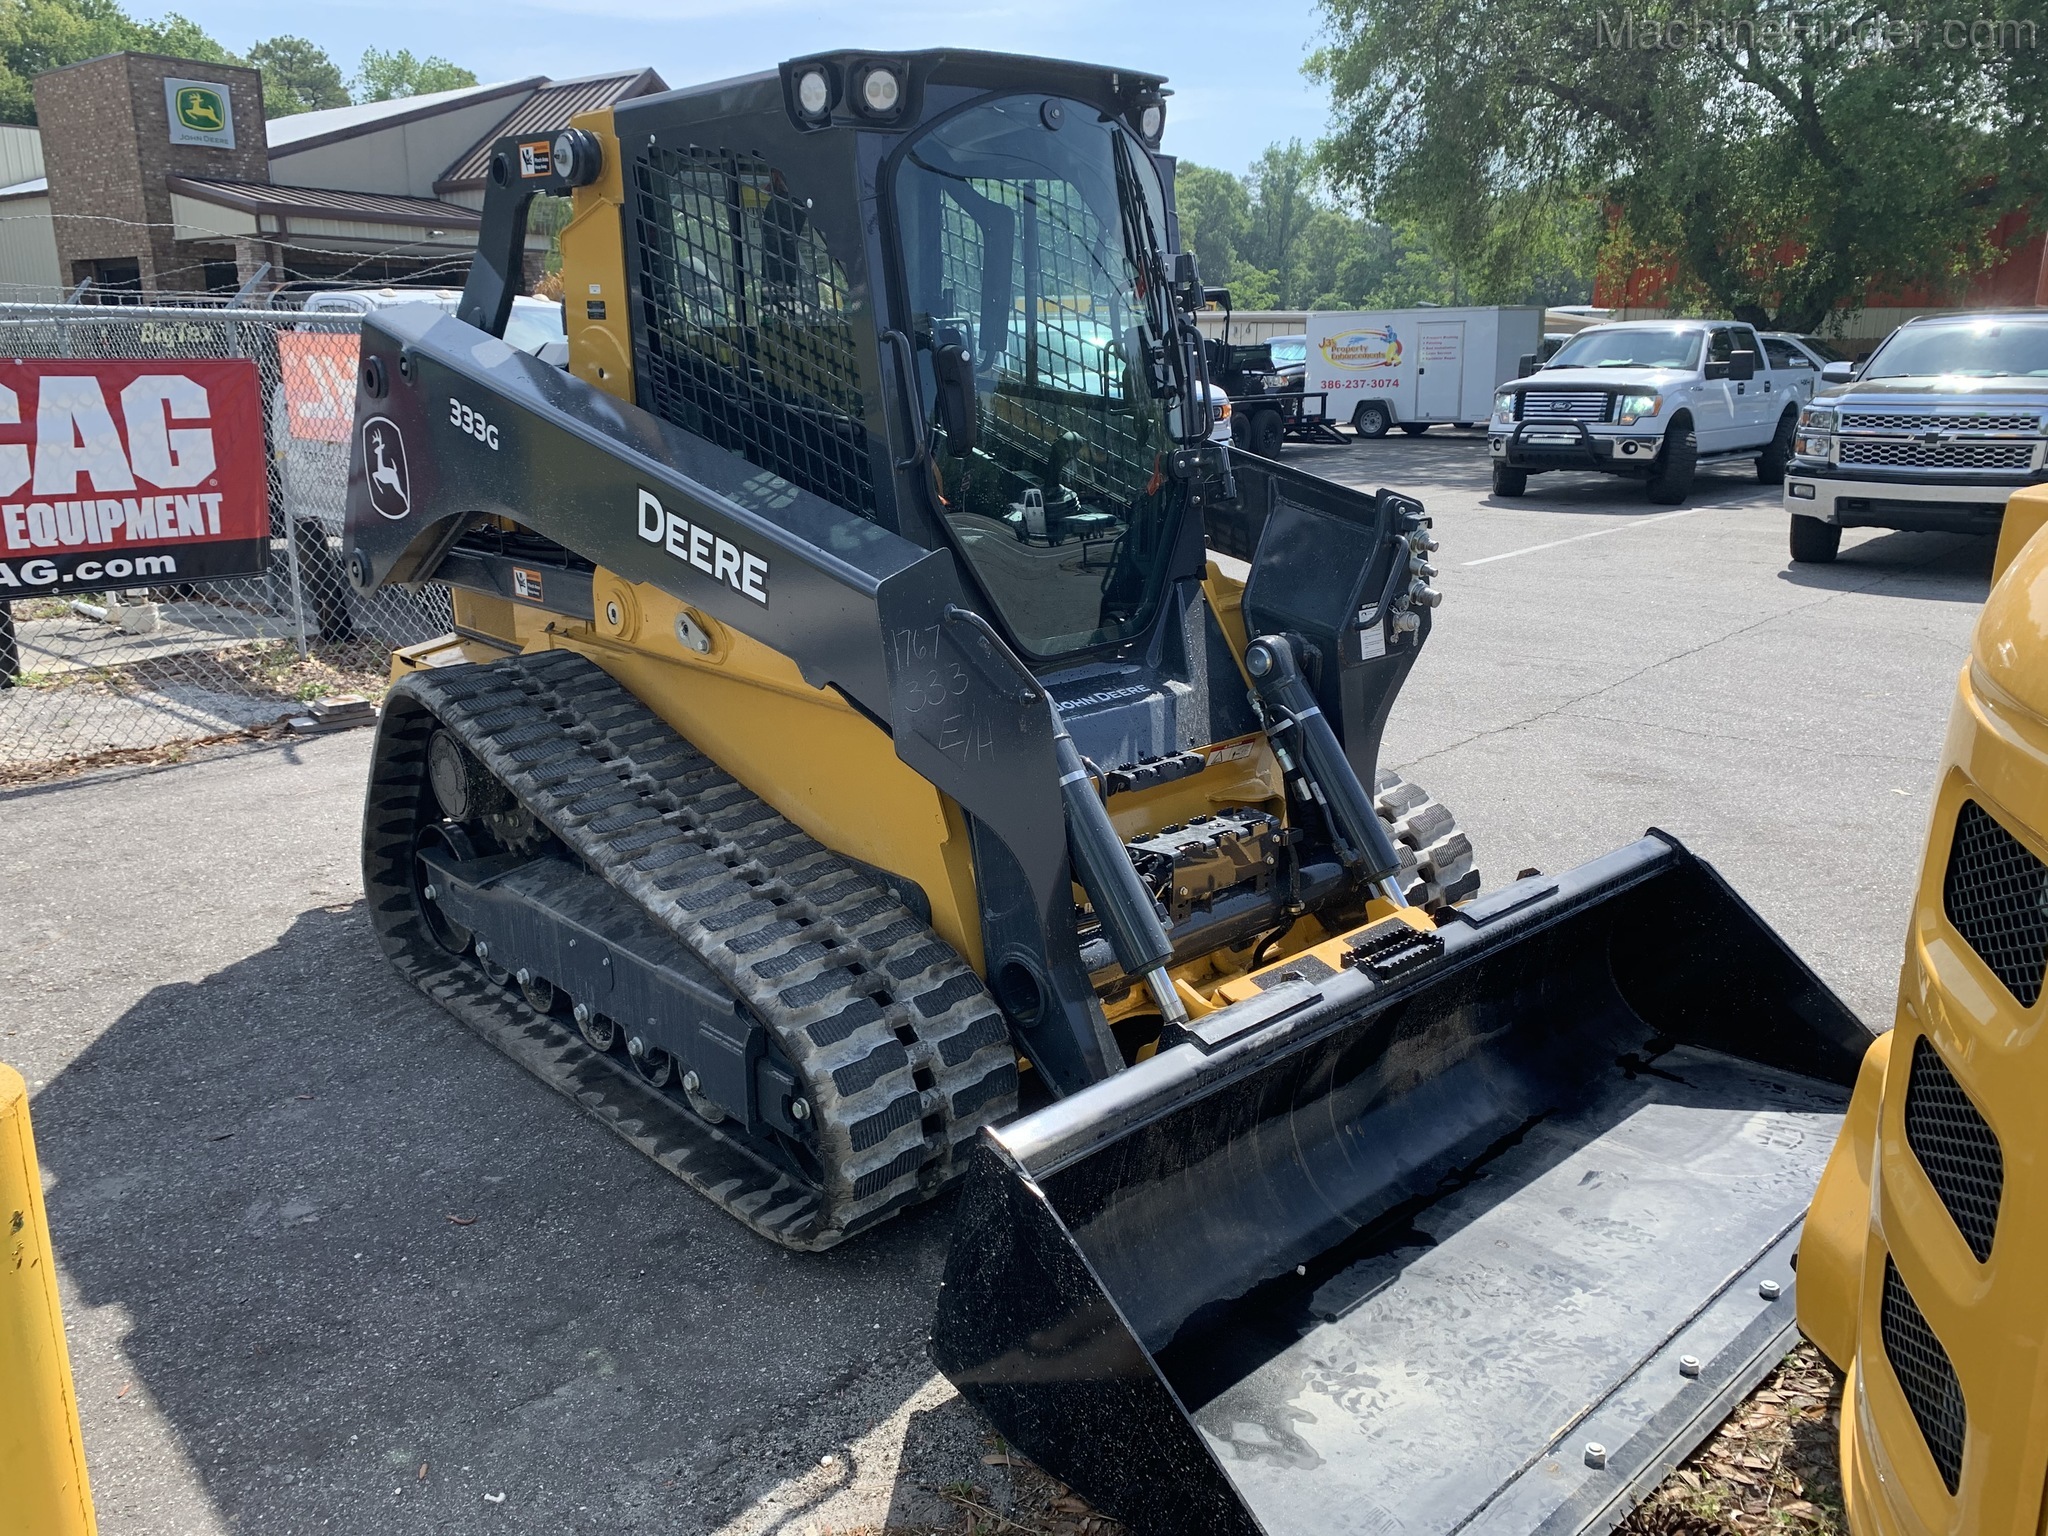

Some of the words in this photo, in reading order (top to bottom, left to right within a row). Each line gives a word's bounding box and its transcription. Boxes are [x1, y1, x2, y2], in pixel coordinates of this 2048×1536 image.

[203, 135, 229, 144] DEERE
[1331, 344, 1369, 354] Property
[1331, 351, 1386, 361] Enhancements
[1321, 378, 1400, 389] 386-237-3074
[450, 397, 499, 451] 333G
[1, 493, 223, 550] EQUIPMENT
[638, 488, 768, 604] DEERE
[891, 624, 941, 671] 1767
[904, 662, 969, 713] 333
[1093, 684, 1151, 703] DEERE
[938, 703, 996, 762] E/H
